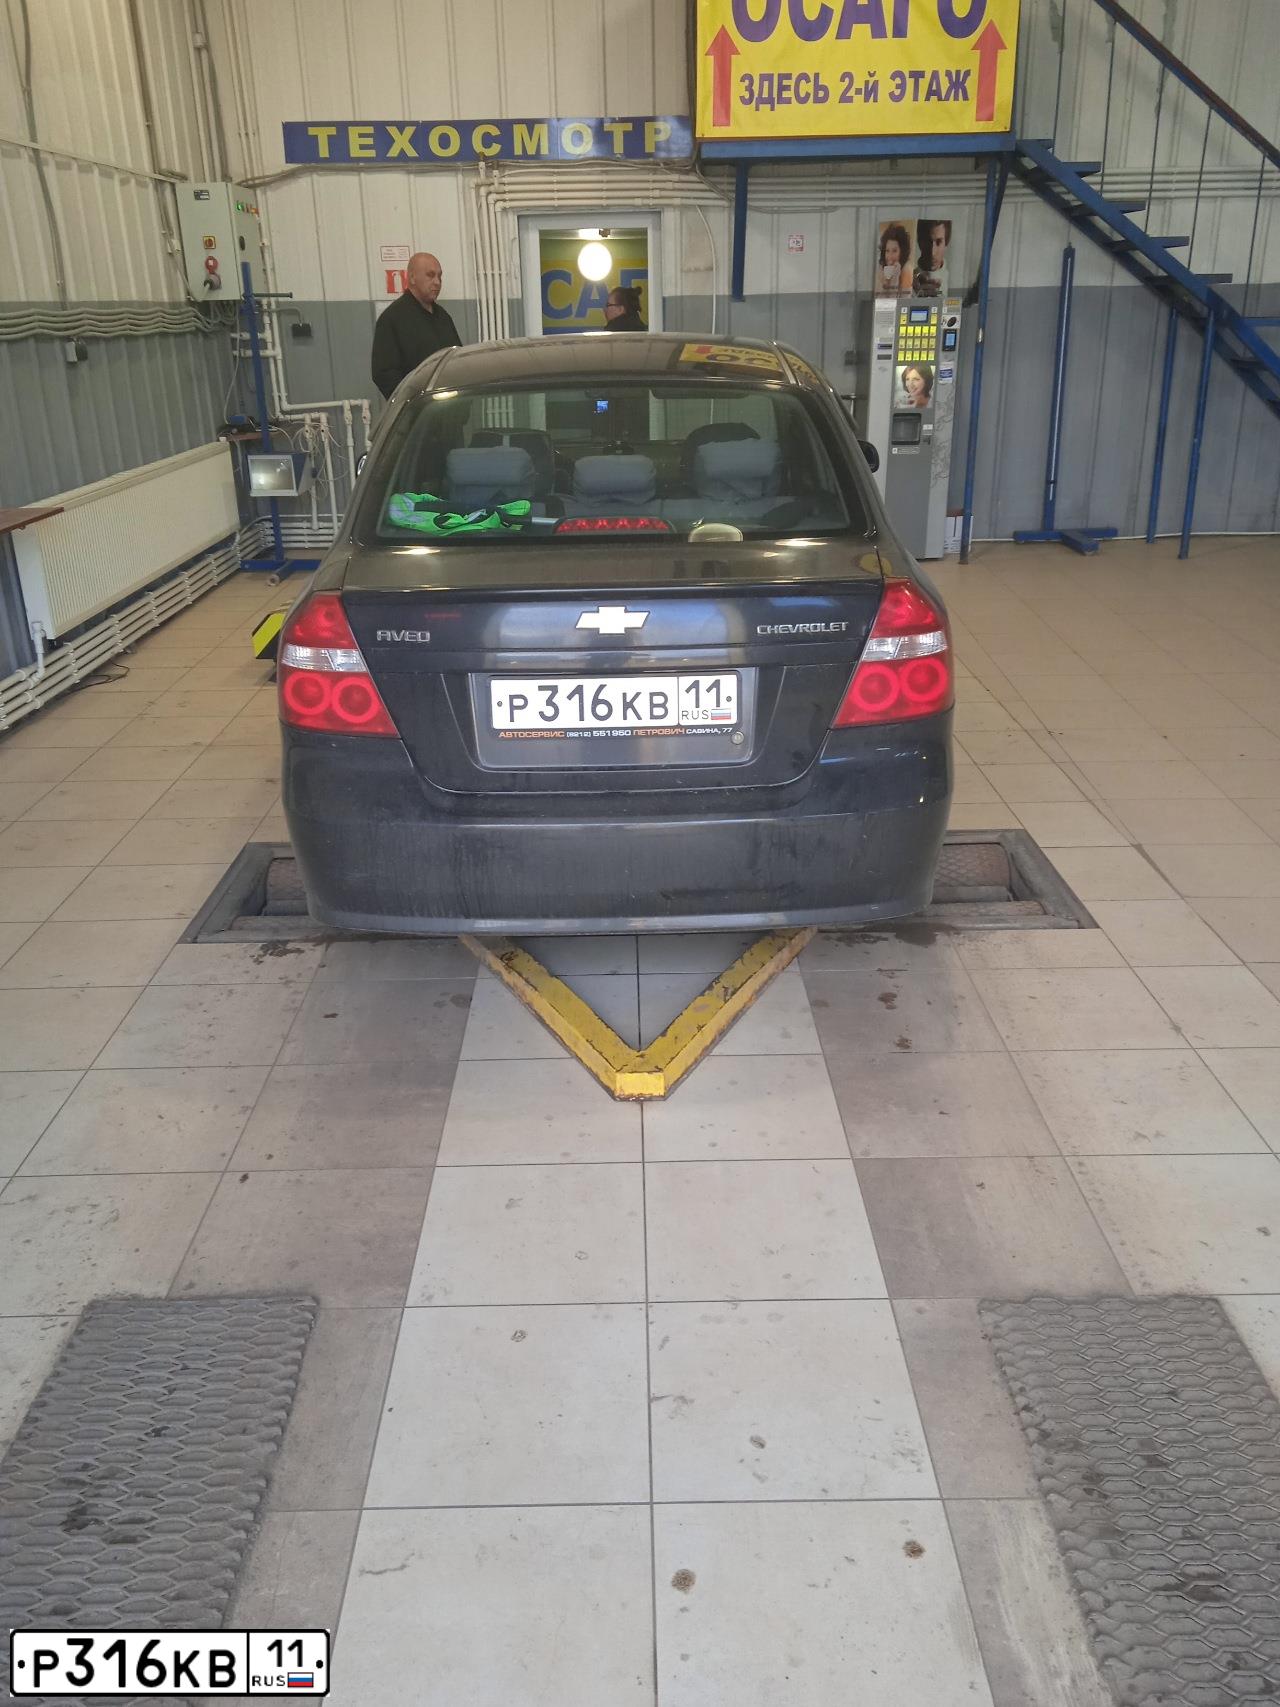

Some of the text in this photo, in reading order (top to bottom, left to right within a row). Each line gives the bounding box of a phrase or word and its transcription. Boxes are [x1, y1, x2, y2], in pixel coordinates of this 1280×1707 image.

[739, 69, 971, 111] ЗДЕСЬ 2-й ЭТАЖ
[308, 122, 672, 159] ТЕХОСМОТР
[756, 621, 849, 635] CHEVROLET
[376, 629, 431, 642] AVEO
[685, 678, 721, 709] 11
[681, 709, 709, 721] RUS
[498, 730, 565, 738] АВТОСЕРВИС
[633, 727, 685, 736] ПЕТРОВИЧ
